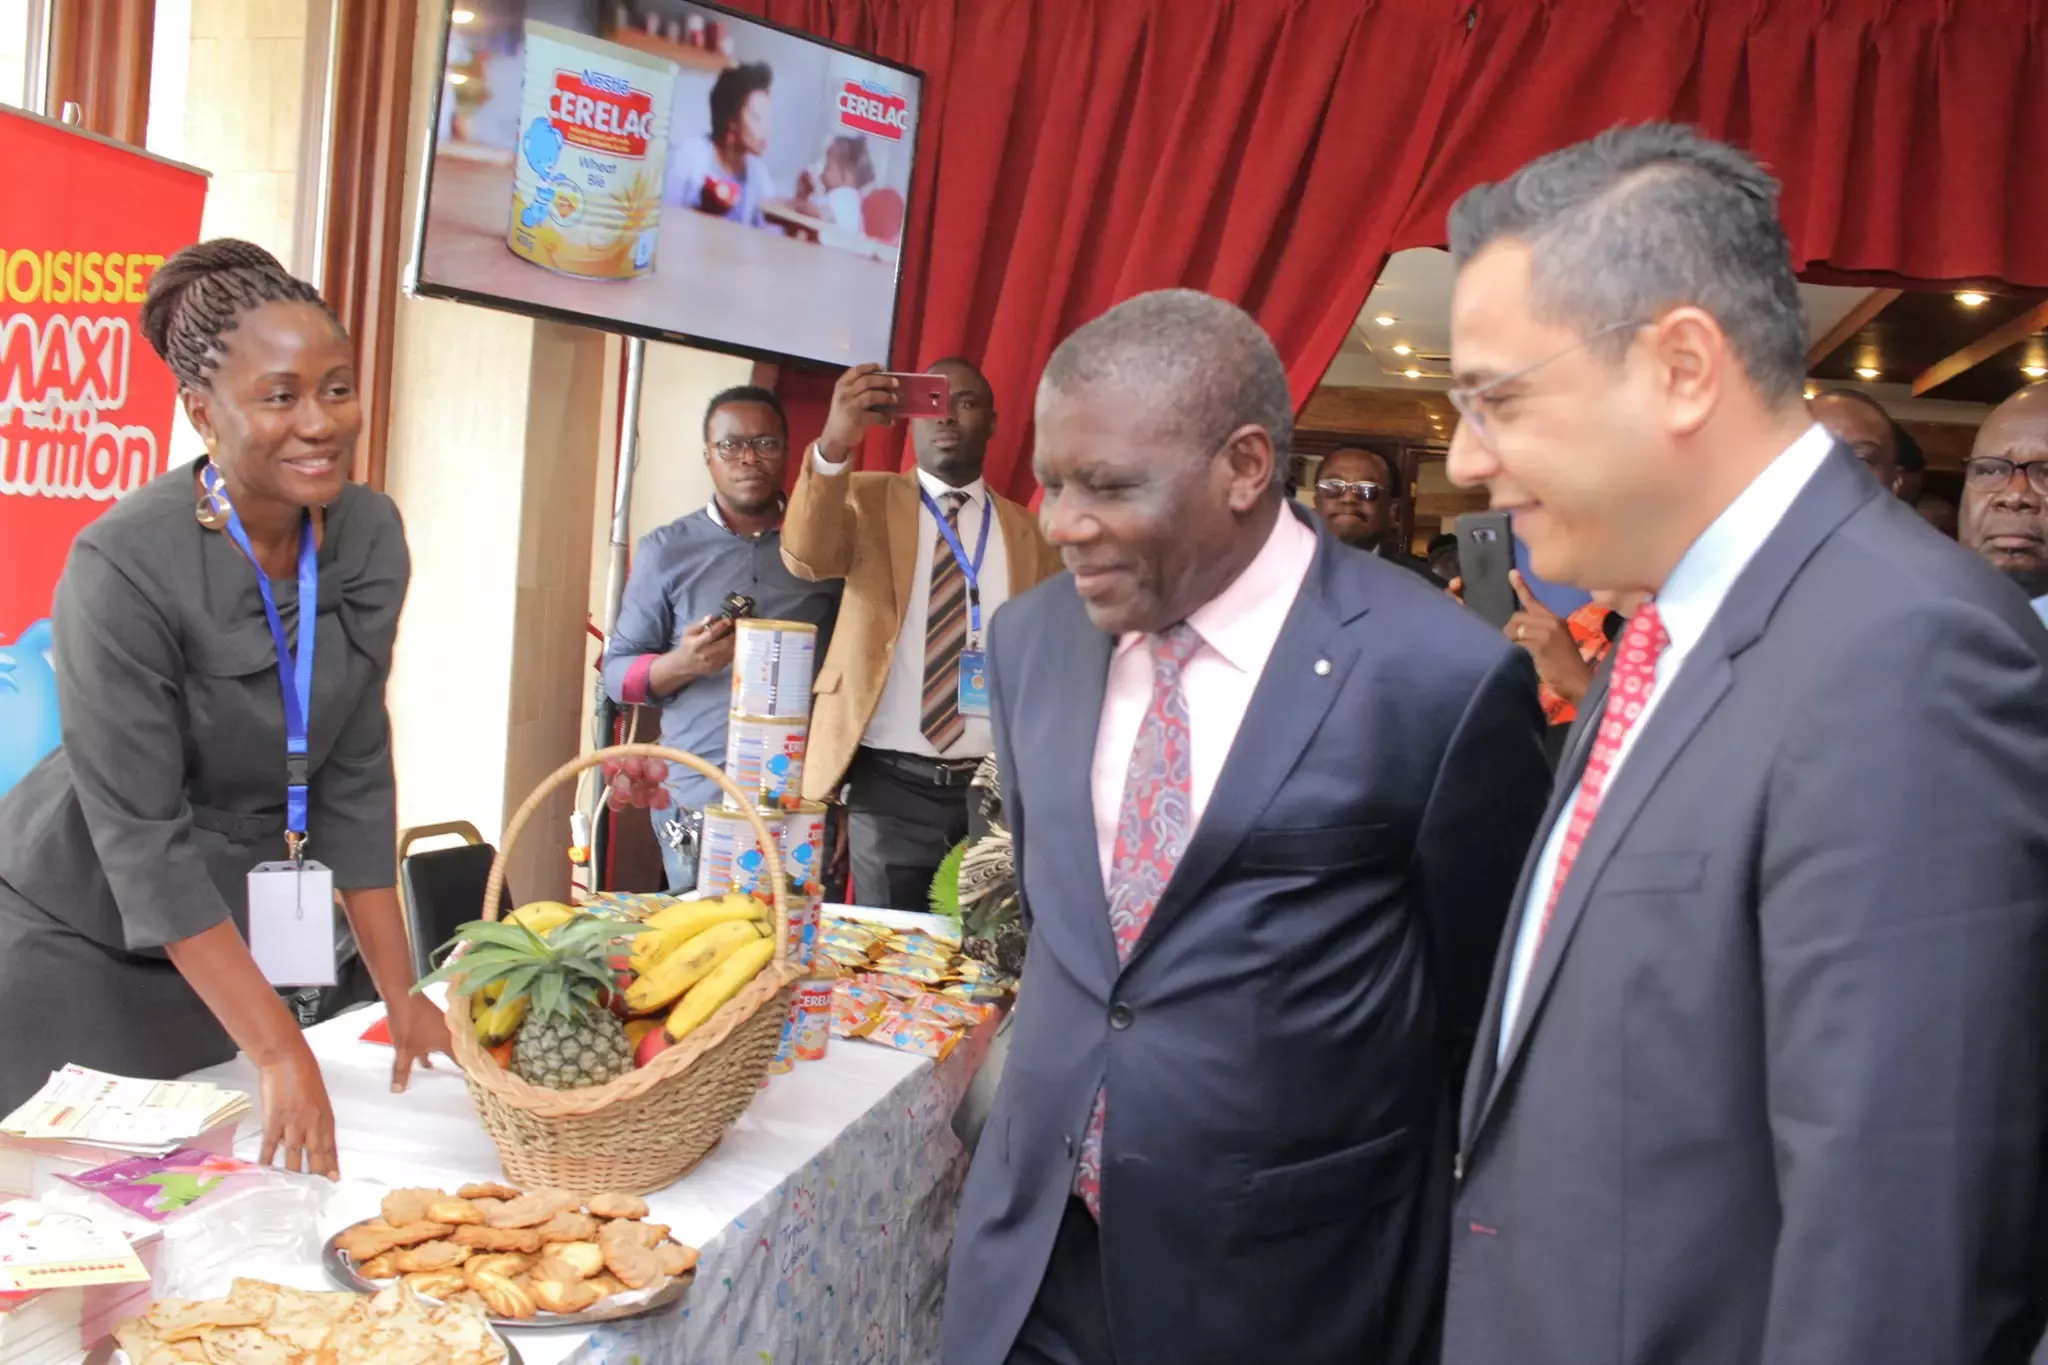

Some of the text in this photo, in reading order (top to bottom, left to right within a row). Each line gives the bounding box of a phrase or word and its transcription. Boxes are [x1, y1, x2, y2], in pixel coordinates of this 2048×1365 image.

[549, 87, 655, 141] CERELAC
[837, 91, 909, 131] CERELAC
[578, 155, 617, 174] Wheat
